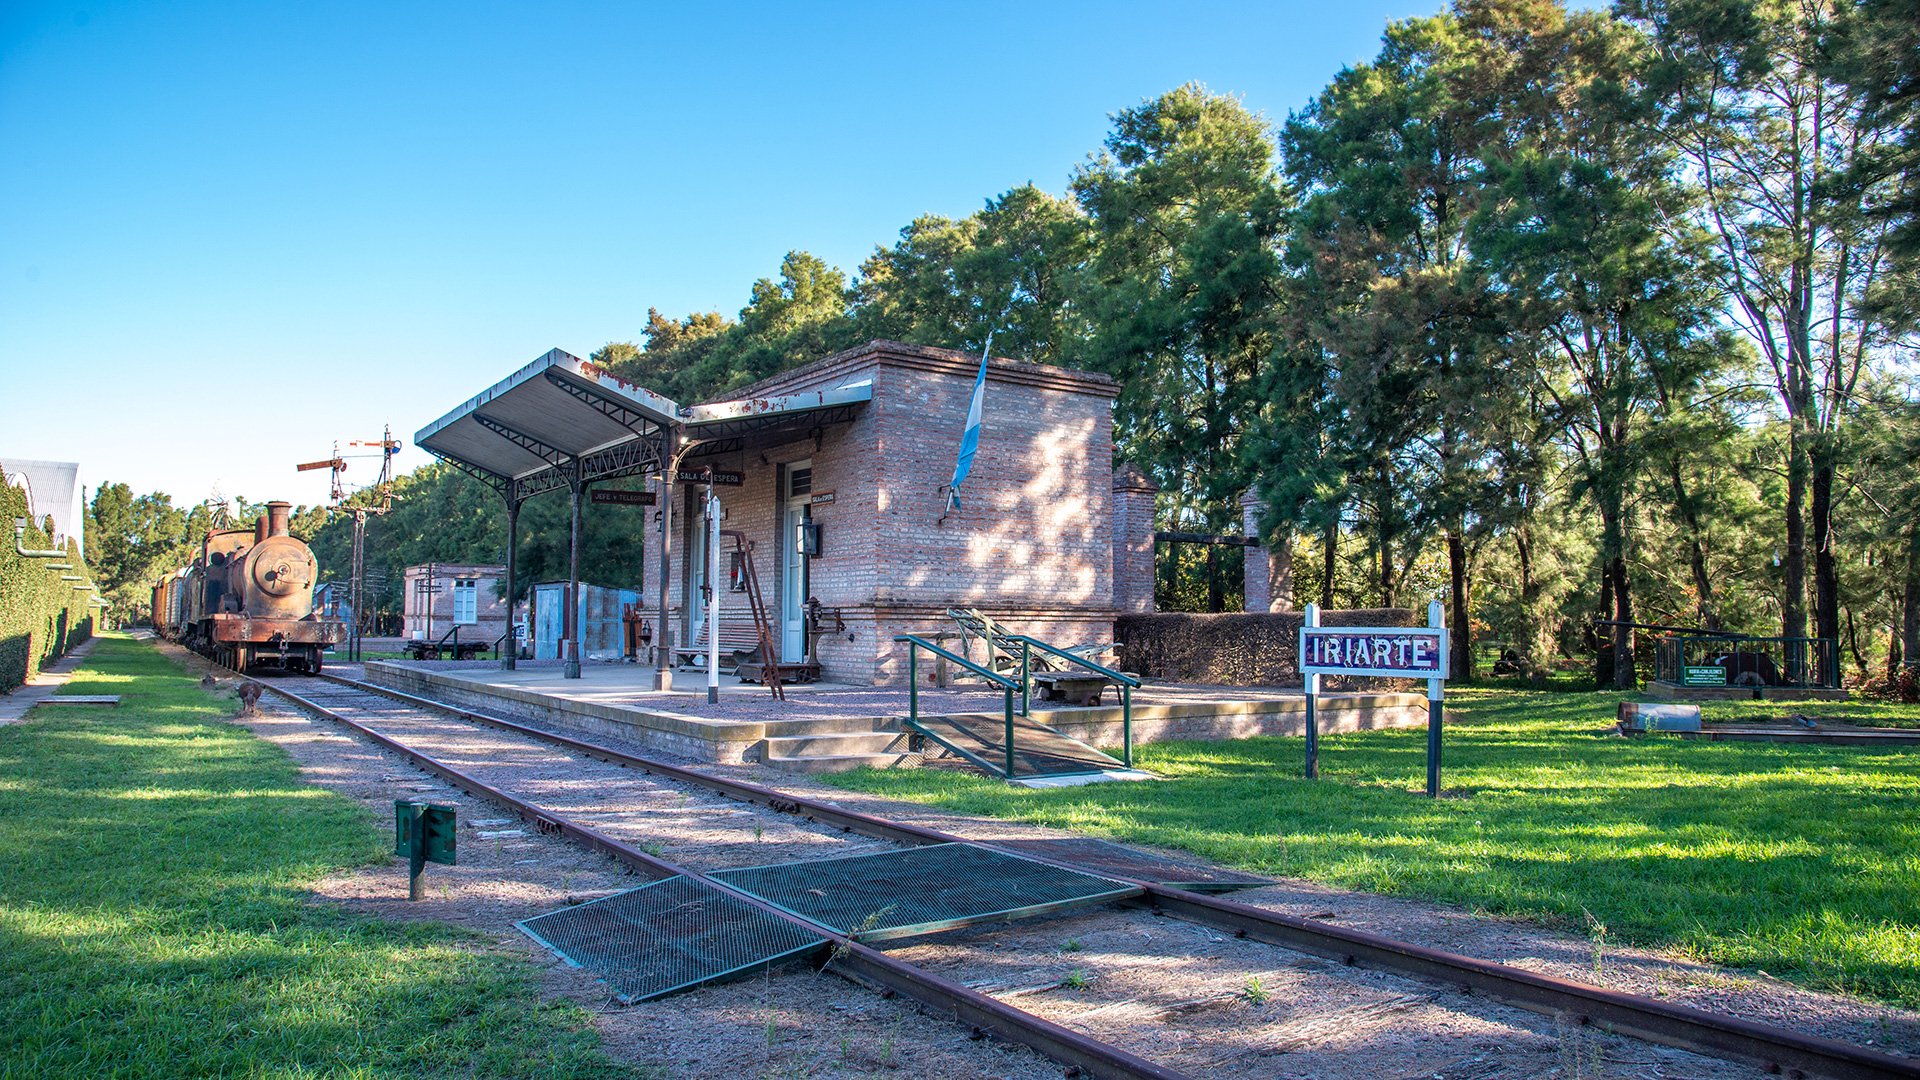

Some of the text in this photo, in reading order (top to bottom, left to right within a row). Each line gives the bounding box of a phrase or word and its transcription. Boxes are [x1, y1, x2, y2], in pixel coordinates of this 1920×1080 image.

[680, 472, 739, 483] SALA DE ESPERA
[619, 494, 653, 503] TELEGRAFO
[1313, 637, 1432, 667] IRIARTE
